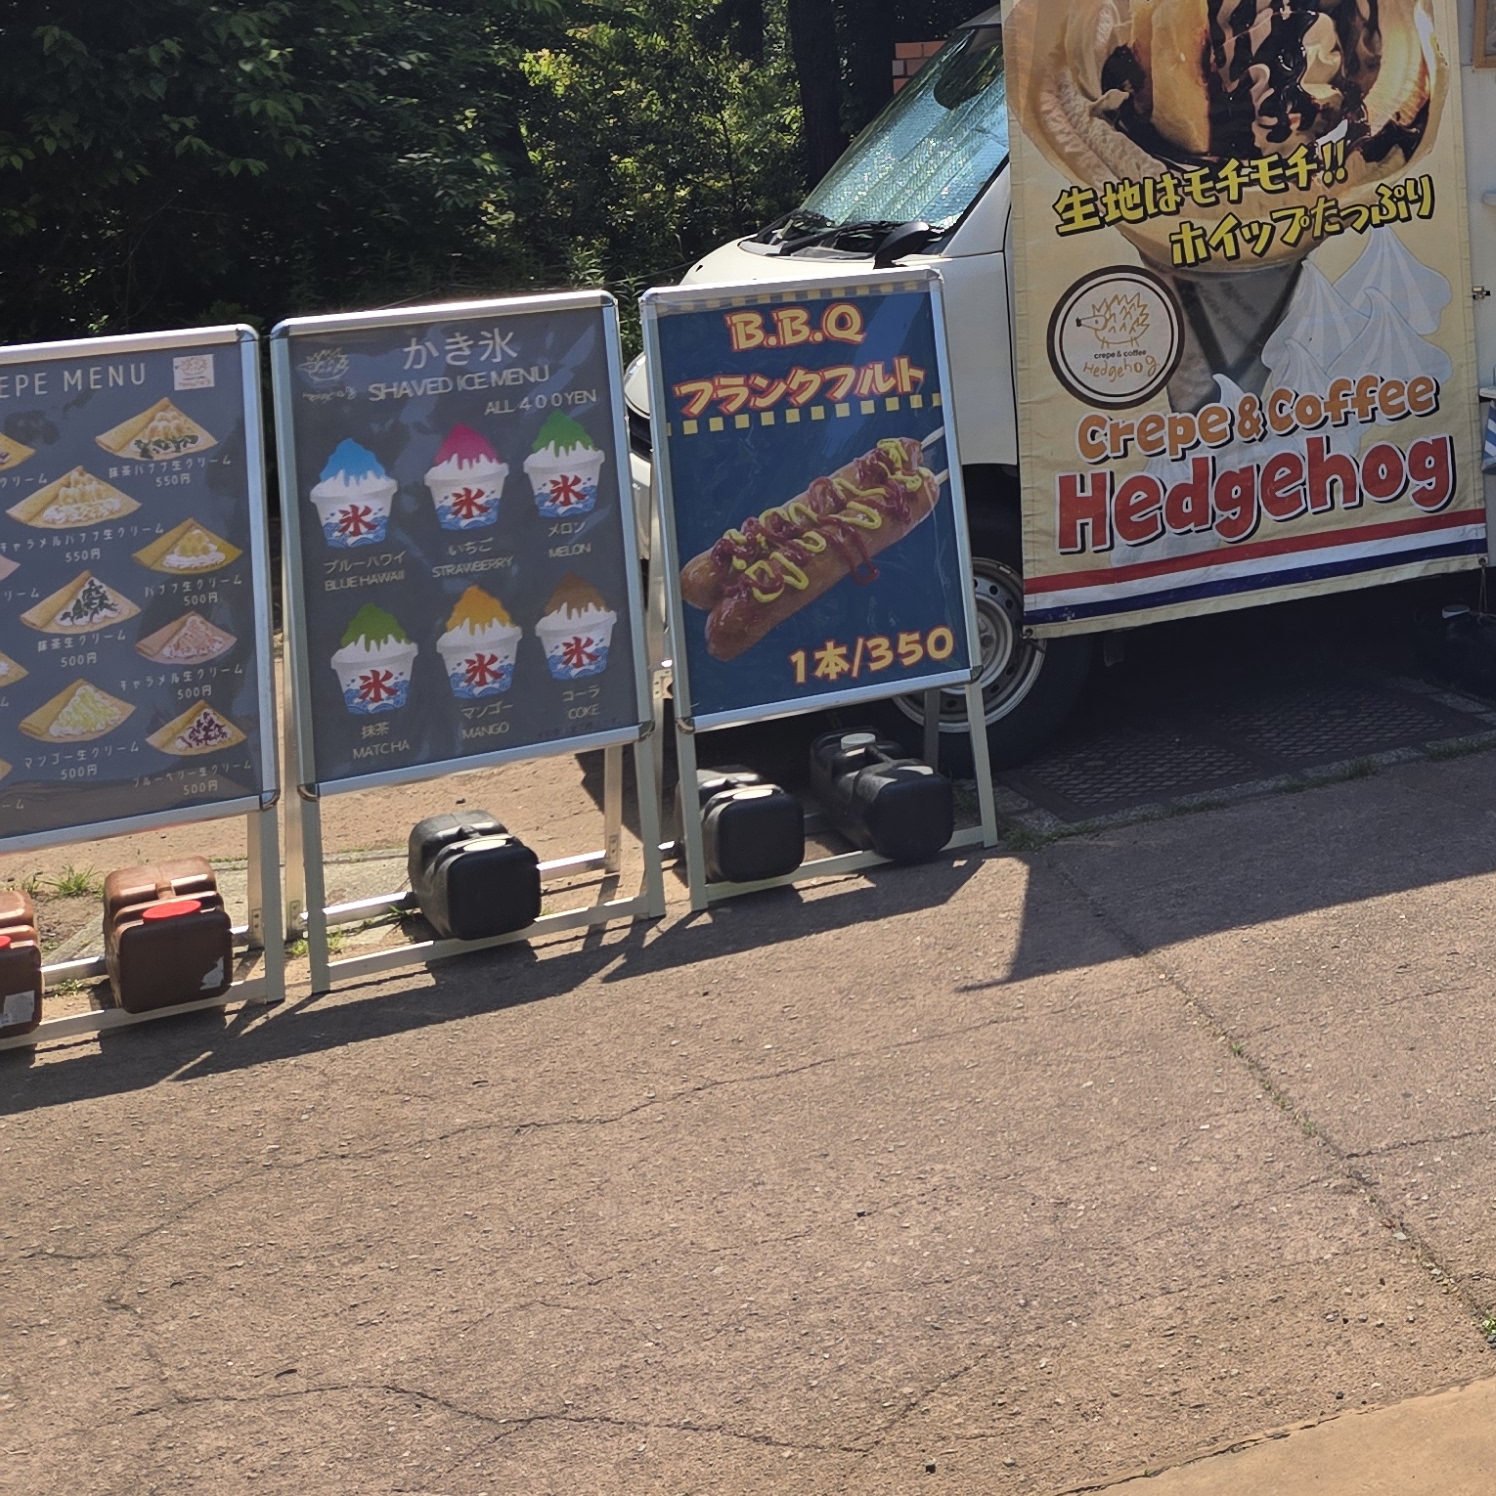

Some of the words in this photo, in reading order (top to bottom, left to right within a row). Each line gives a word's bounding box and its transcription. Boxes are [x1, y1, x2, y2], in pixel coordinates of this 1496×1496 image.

[1169, 175, 1436, 268] ホイップたっぷり
[725, 301, 867, 351] B.B.Q
[402, 327, 519, 371] かき氷
[1093, 352, 1116, 360] crepe
[1123, 349, 1147, 358] coffee
[63, 362, 147, 393] MENU
[1083, 355, 1158, 382] Hedgehog
[368, 376, 454, 402] SHAVED
[457, 371, 488, 392] ICE
[491, 365, 550, 388] MENU
[673, 355, 926, 418] フランクフルト
[485, 398, 516, 415] ALL
[155, 472, 192, 488] 550円
[550, 474, 588, 506] 氷
[452, 487, 490, 519] 氷
[1056, 432, 1457, 555] Hedgehog
[338, 504, 379, 537] 氷
[548, 521, 588, 536] メロン
[65, 547, 101, 563] 550円
[449, 537, 495, 556] いちご
[548, 542, 592, 559] MELON
[323, 550, 406, 574] ブルーハワイ
[431, 555, 514, 578] STRAWBERRY
[324, 574, 358, 592] BLUE
[183, 590, 219, 607] 500円
[60, 651, 98, 668] 500円
[561, 636, 599, 669] 氷
[789, 626, 956, 686] 1本/350
[464, 653, 504, 687] 氷
[177, 684, 213, 700] 500円
[358, 669, 399, 703] 氷
[562, 685, 600, 702] コーラ
[461, 701, 514, 719] マンゴー
[567, 703, 600, 720] COKE
[360, 721, 390, 739] 抹茶
[462, 722, 510, 740] MANGO
[24, 741, 140, 770] マンゴー生クリーム
[353, 739, 410, 760] MATCHA
[60, 763, 98, 781] 500円
[183, 779, 219, 796] 500円
